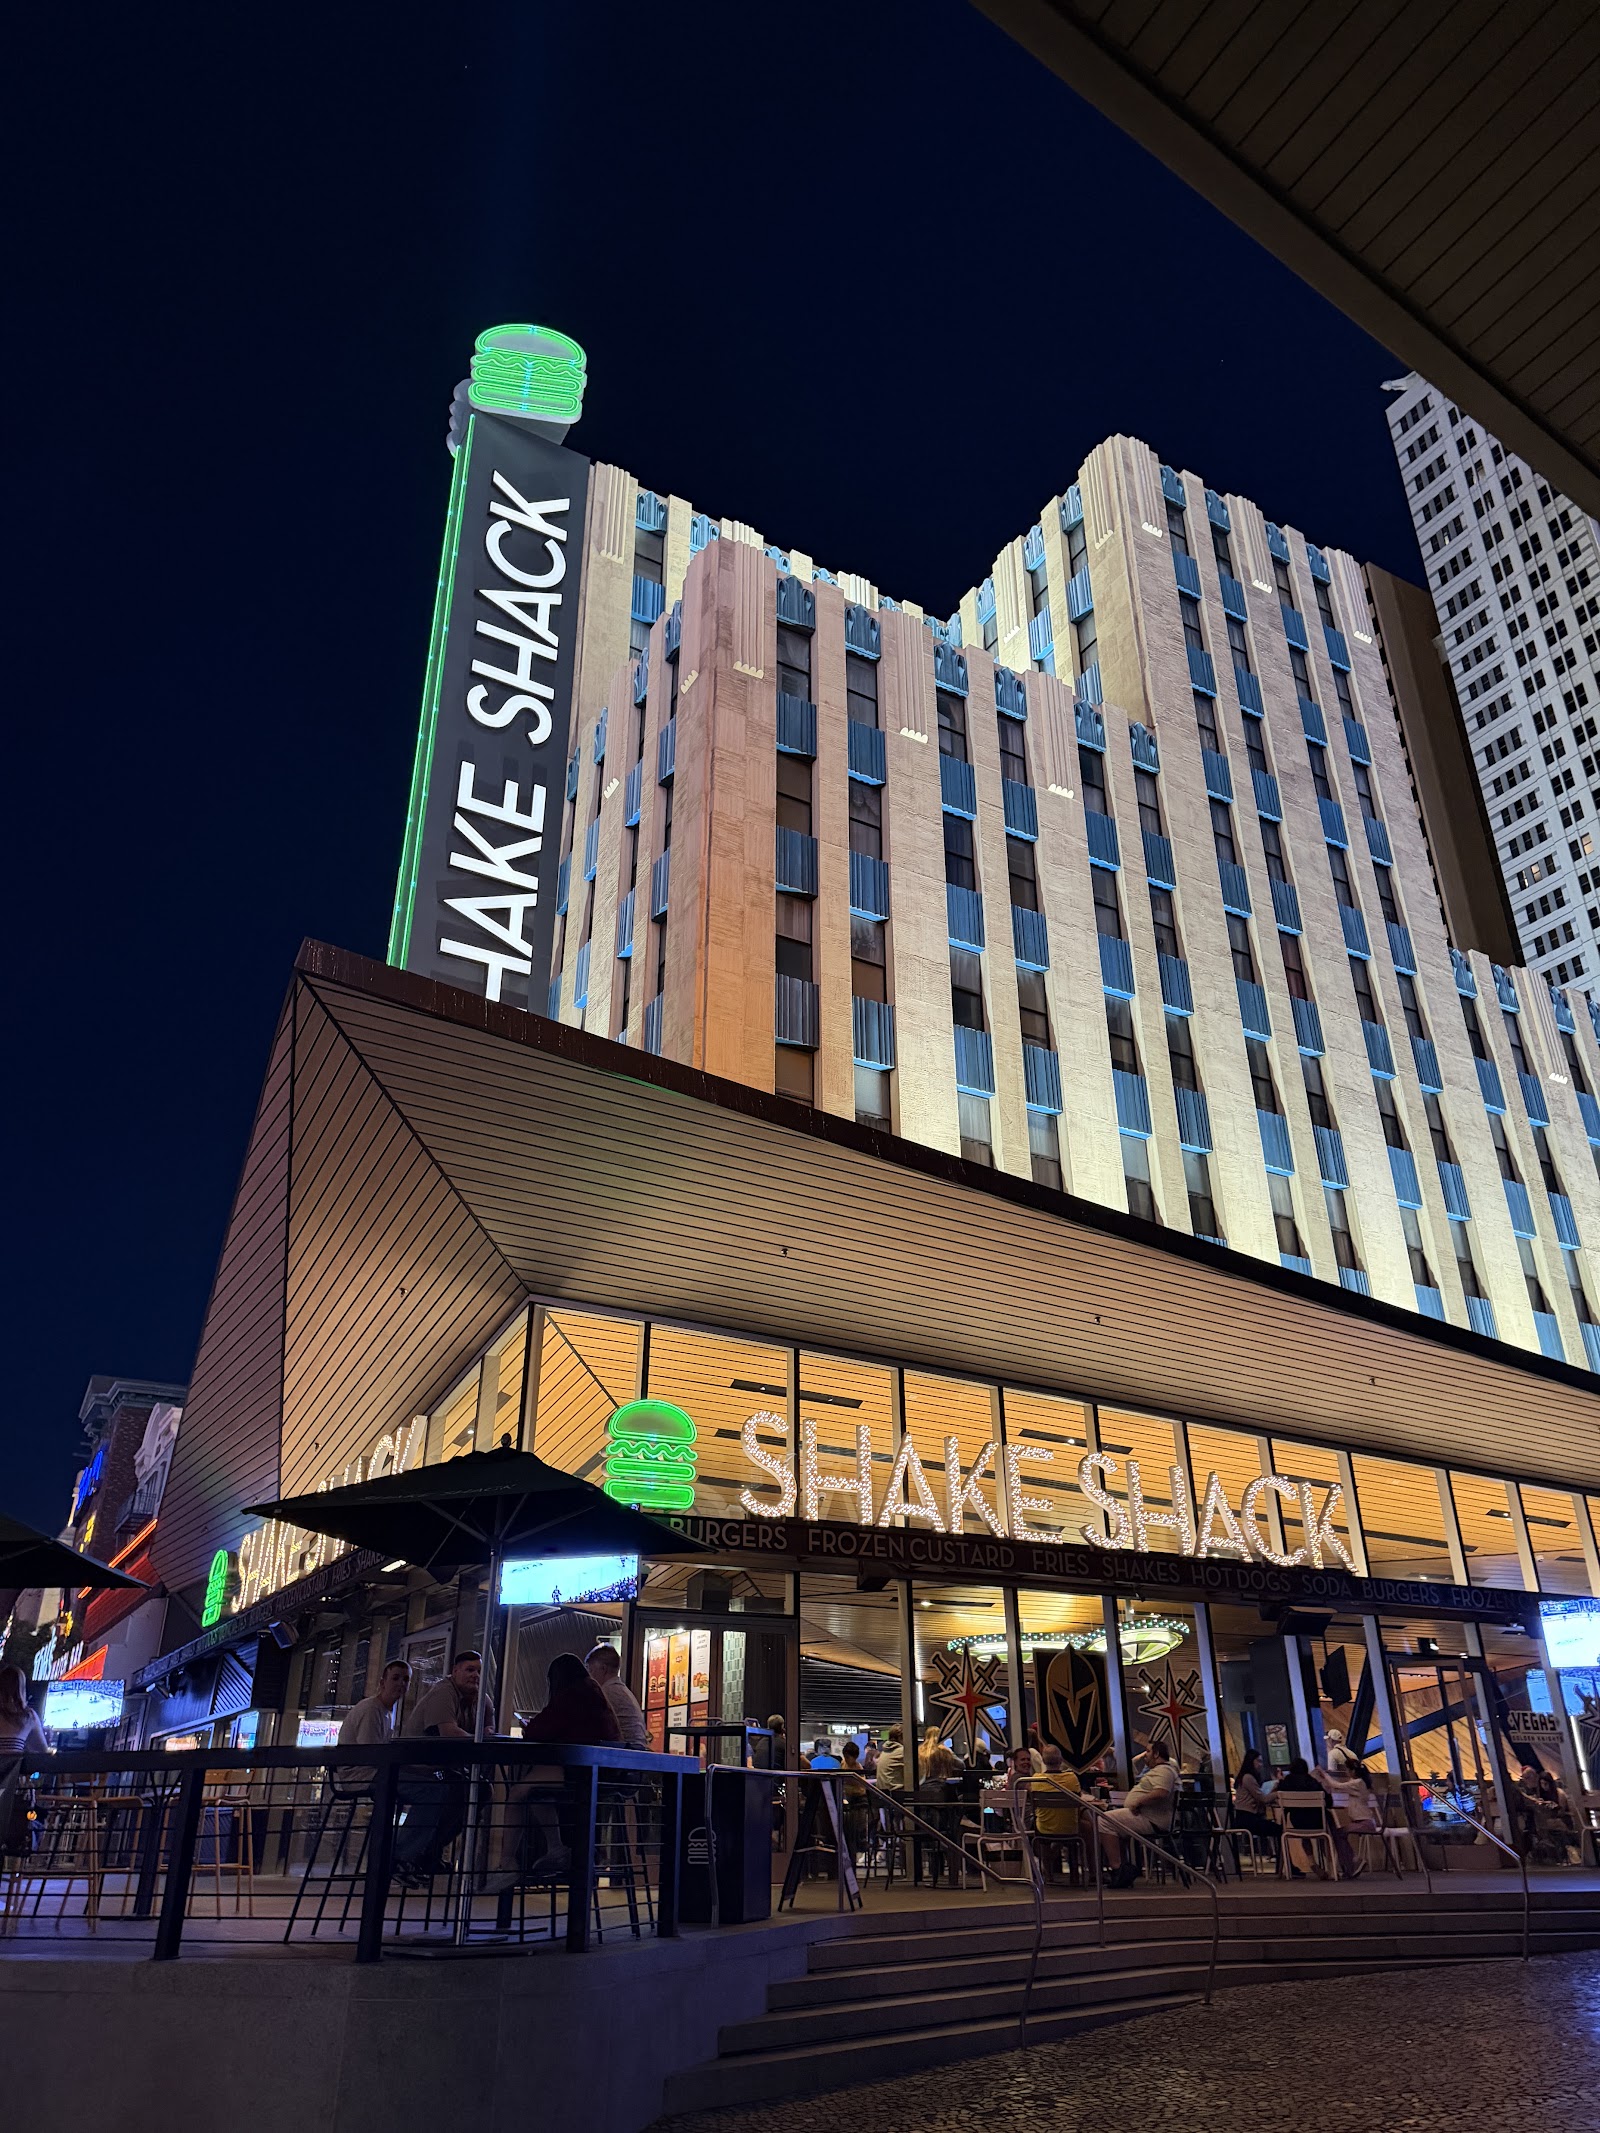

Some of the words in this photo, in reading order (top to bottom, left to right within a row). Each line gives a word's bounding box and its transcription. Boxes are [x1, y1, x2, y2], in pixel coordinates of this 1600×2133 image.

[467, 470, 570, 745] SHACK
[440, 761, 547, 1003] HAKE
[669, 1517, 788, 1550] BURGERS
[808, 1528, 905, 1560] FROZEN
[909, 1537, 1015, 1568] CUSTARD
[1033, 1550, 1090, 1576] FRIES
[1103, 1557, 1180, 1583] SHAKES
[1191, 1565, 1233, 1586] HOT
[1236, 1569, 1290, 1593] DOGS
[1302, 1574, 1352, 1597] SODA
[1363, 1579, 1440, 1605] BURGERS
[1451, 1587, 1517, 1611] FROZEN
[738, 1410, 1063, 1545] SHAKE
[1077, 1452, 1358, 1573] SHACK
[1510, 1712, 1557, 1732] VEGAS
